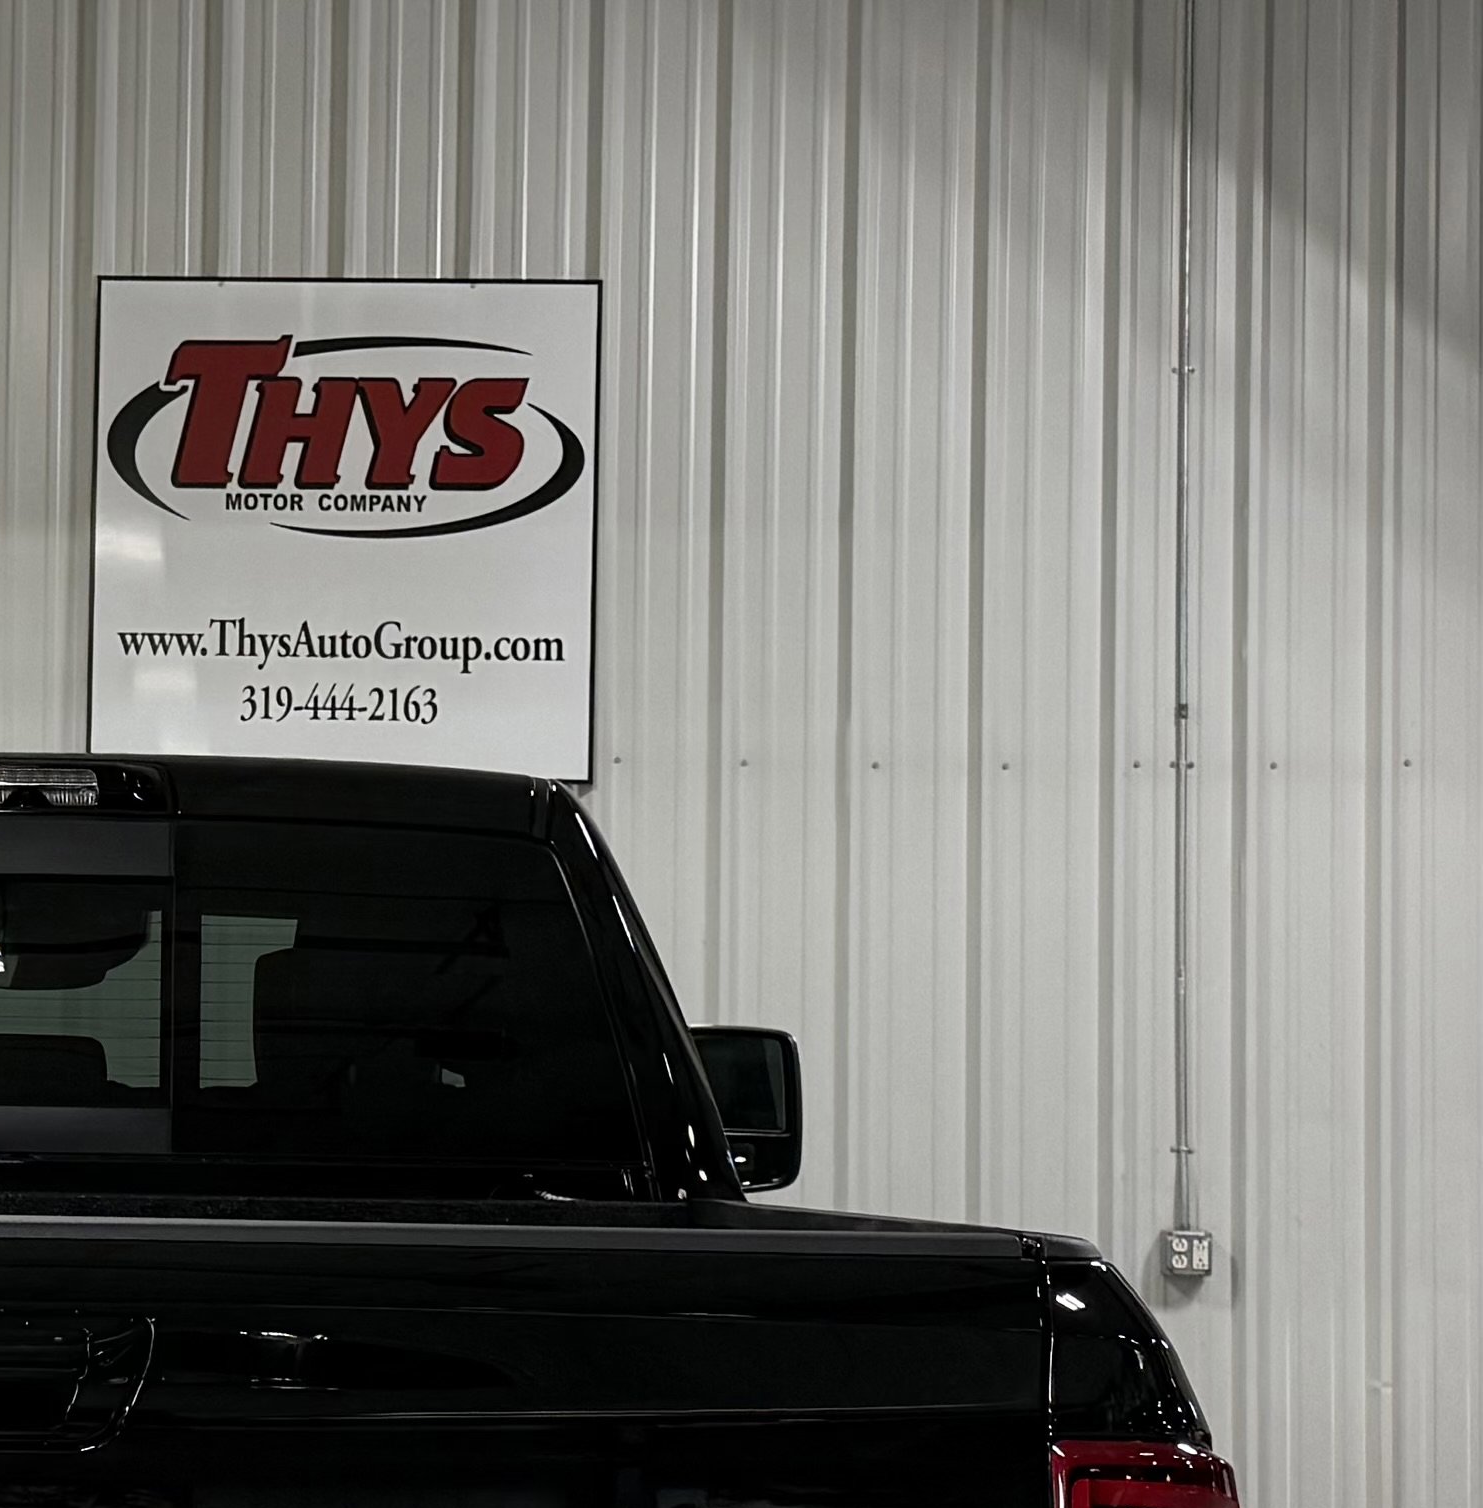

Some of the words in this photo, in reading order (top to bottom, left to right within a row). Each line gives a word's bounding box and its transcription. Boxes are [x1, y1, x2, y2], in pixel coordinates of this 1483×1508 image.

[165, 334, 530, 491] THYS
[224, 492, 304, 512] MOTOR
[317, 493, 428, 514] COMPANY
[117, 617, 566, 674] www.ThysAutoGroup.com
[239, 682, 439, 725] 319-444-2163
